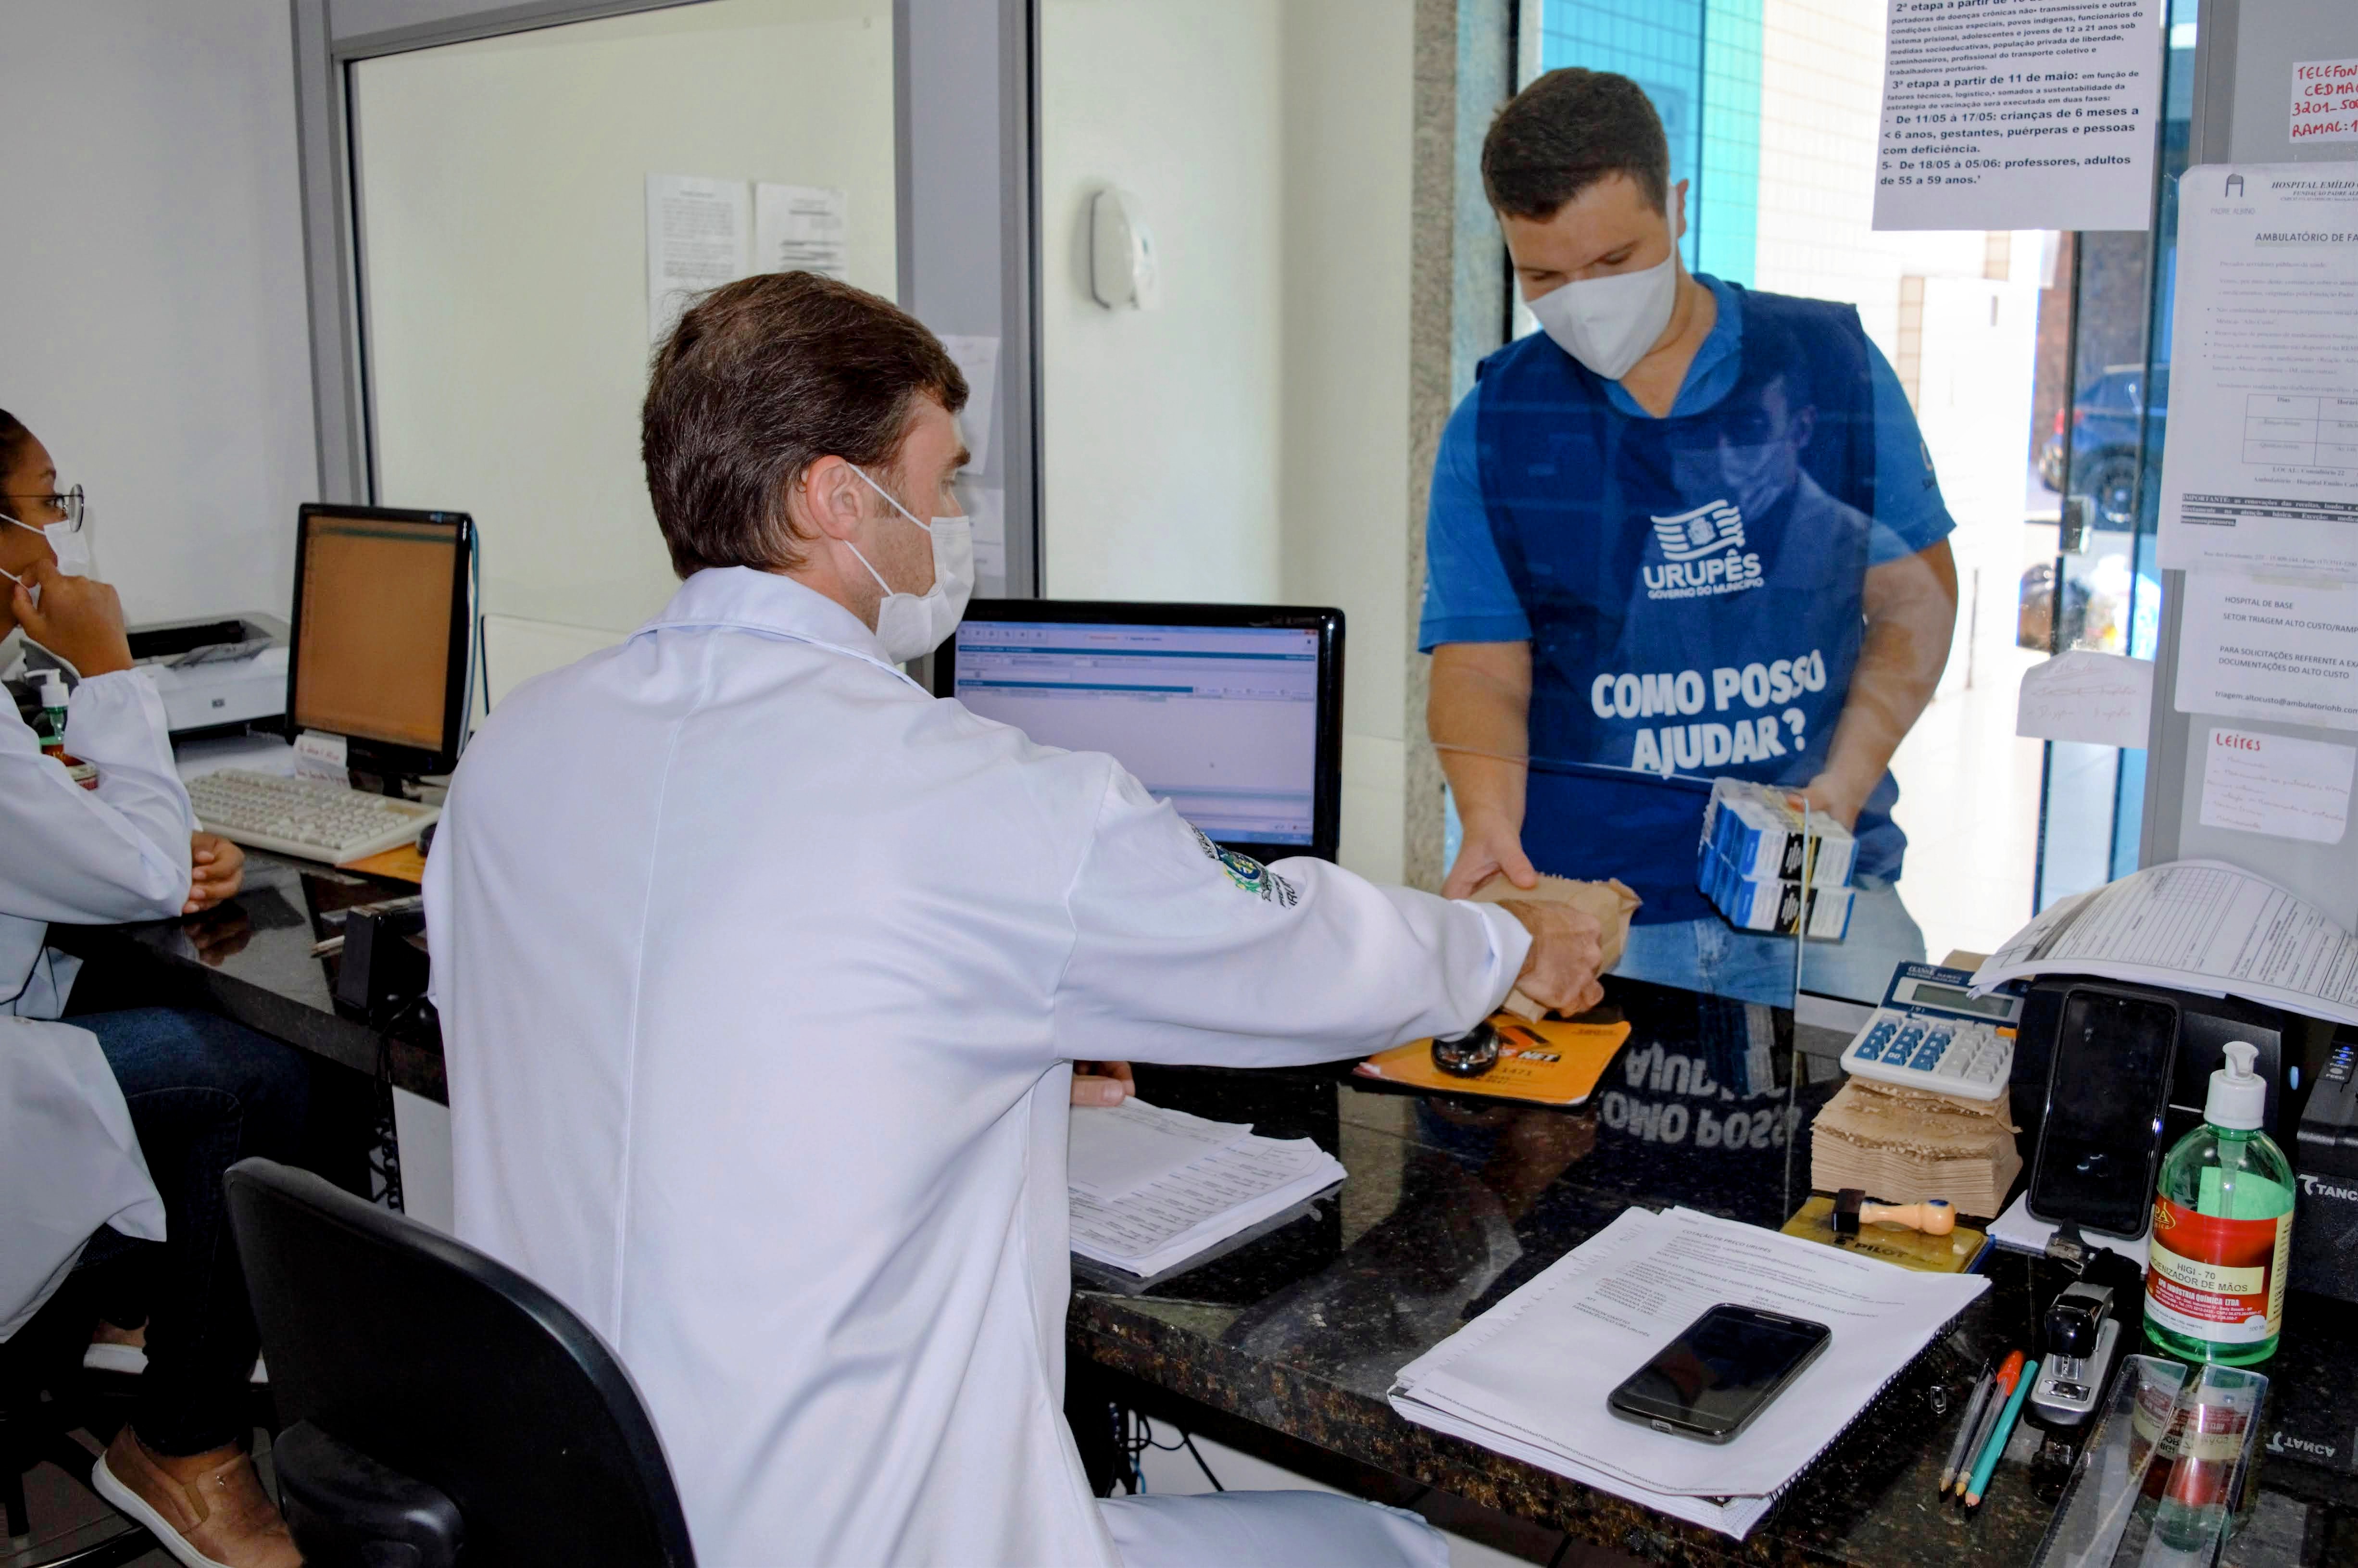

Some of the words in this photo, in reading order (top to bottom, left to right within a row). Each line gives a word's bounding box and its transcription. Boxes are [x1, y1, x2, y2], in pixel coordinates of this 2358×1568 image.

[1911, 3, 1943, 12] etapa
[1965, 22, 2005, 30] especiais,
[2078, 12, 2130, 21] funcionários
[1923, 35, 1959, 44] prisional,
[1961, 31, 2014, 40] adolescentes
[2023, 29, 2050, 37] jovens
[1925, 44, 1991, 53] socioeducativas,
[1993, 40, 2035, 50] população
[2037, 38, 2067, 47] privada
[2082, 34, 2124, 42] liberdade,
[1906, 80, 1939, 89] etapa
[1954, 76, 1986, 88] partir
[1990, 75, 2004, 84] de
[2008, 74, 2021, 83] 11
[2026, 73, 2041, 82] de
[2045, 71, 2078, 81] maio:
[1896, 115, 1911, 124] De
[1907, 113, 1946, 123] 11/05
[1962, 112, 1996, 122] 17/05:
[2000, 111, 2052, 121] crianças
[2056, 109, 2071, 118] de
[2075, 108, 2082, 117] 6
[2087, 108, 2127, 117] meses
[1894, 130, 1901, 139] 6
[1940, 129, 2003, 140] gestantes,
[2007, 127, 2068, 138] puérperas
[2083, 125, 2135, 135] pessoas
[1911, 144, 1980, 154] deficiência.
[1900, 161, 1915, 169] De
[1919, 160, 1950, 169] 18/05
[1965, 159, 2001, 168] 05/06:
[2005, 158, 2080, 170] professores,
[2084, 155, 2131, 165] adultos
[1881, 176, 1894, 185] de
[1898, 176, 1912, 185] 55
[1927, 176, 1942, 184] 59
[2271, 181, 2320, 189] HOSPITAL
[2255, 231, 2328, 241] AMBULATÓRIO
[1643, 548, 1762, 590] URUPÊS
[1647, 587, 1696, 600] GOVERNO
[1696, 584, 1713, 596] DO
[1713, 577, 1765, 595] MUNICÍPIO
[2225, 596, 2260, 606] HOSPITAL
[2274, 601, 2293, 609] BASE
[2223, 613, 2246, 621] SETOR
[2249, 615, 2283, 625] TRIAGEM
[2284, 619, 2305, 627] ALTO
[2241, 648, 2293, 660] SOLICITAÇÕES
[2295, 654, 2337, 665] REFERENTE
[2219, 657, 2286, 672] DOCUMENTAÇÕES
[2301, 667, 2321, 676] ALTO
[2323, 669, 2349, 679] CUSTO
[1591, 670, 1706, 719] COMO
[1712, 648, 1827, 712] POSSO
[2316, 1184, 2358, 1202] TANC
[2177, 1263, 2195, 1275] HIGI
[2205, 1271, 2216, 1279] 70
[2201, 1280, 2216, 1289] DE
[2218, 1282, 2248, 1292] MÃOS
[2195, 1294, 2222, 1305] QUÍMICA
